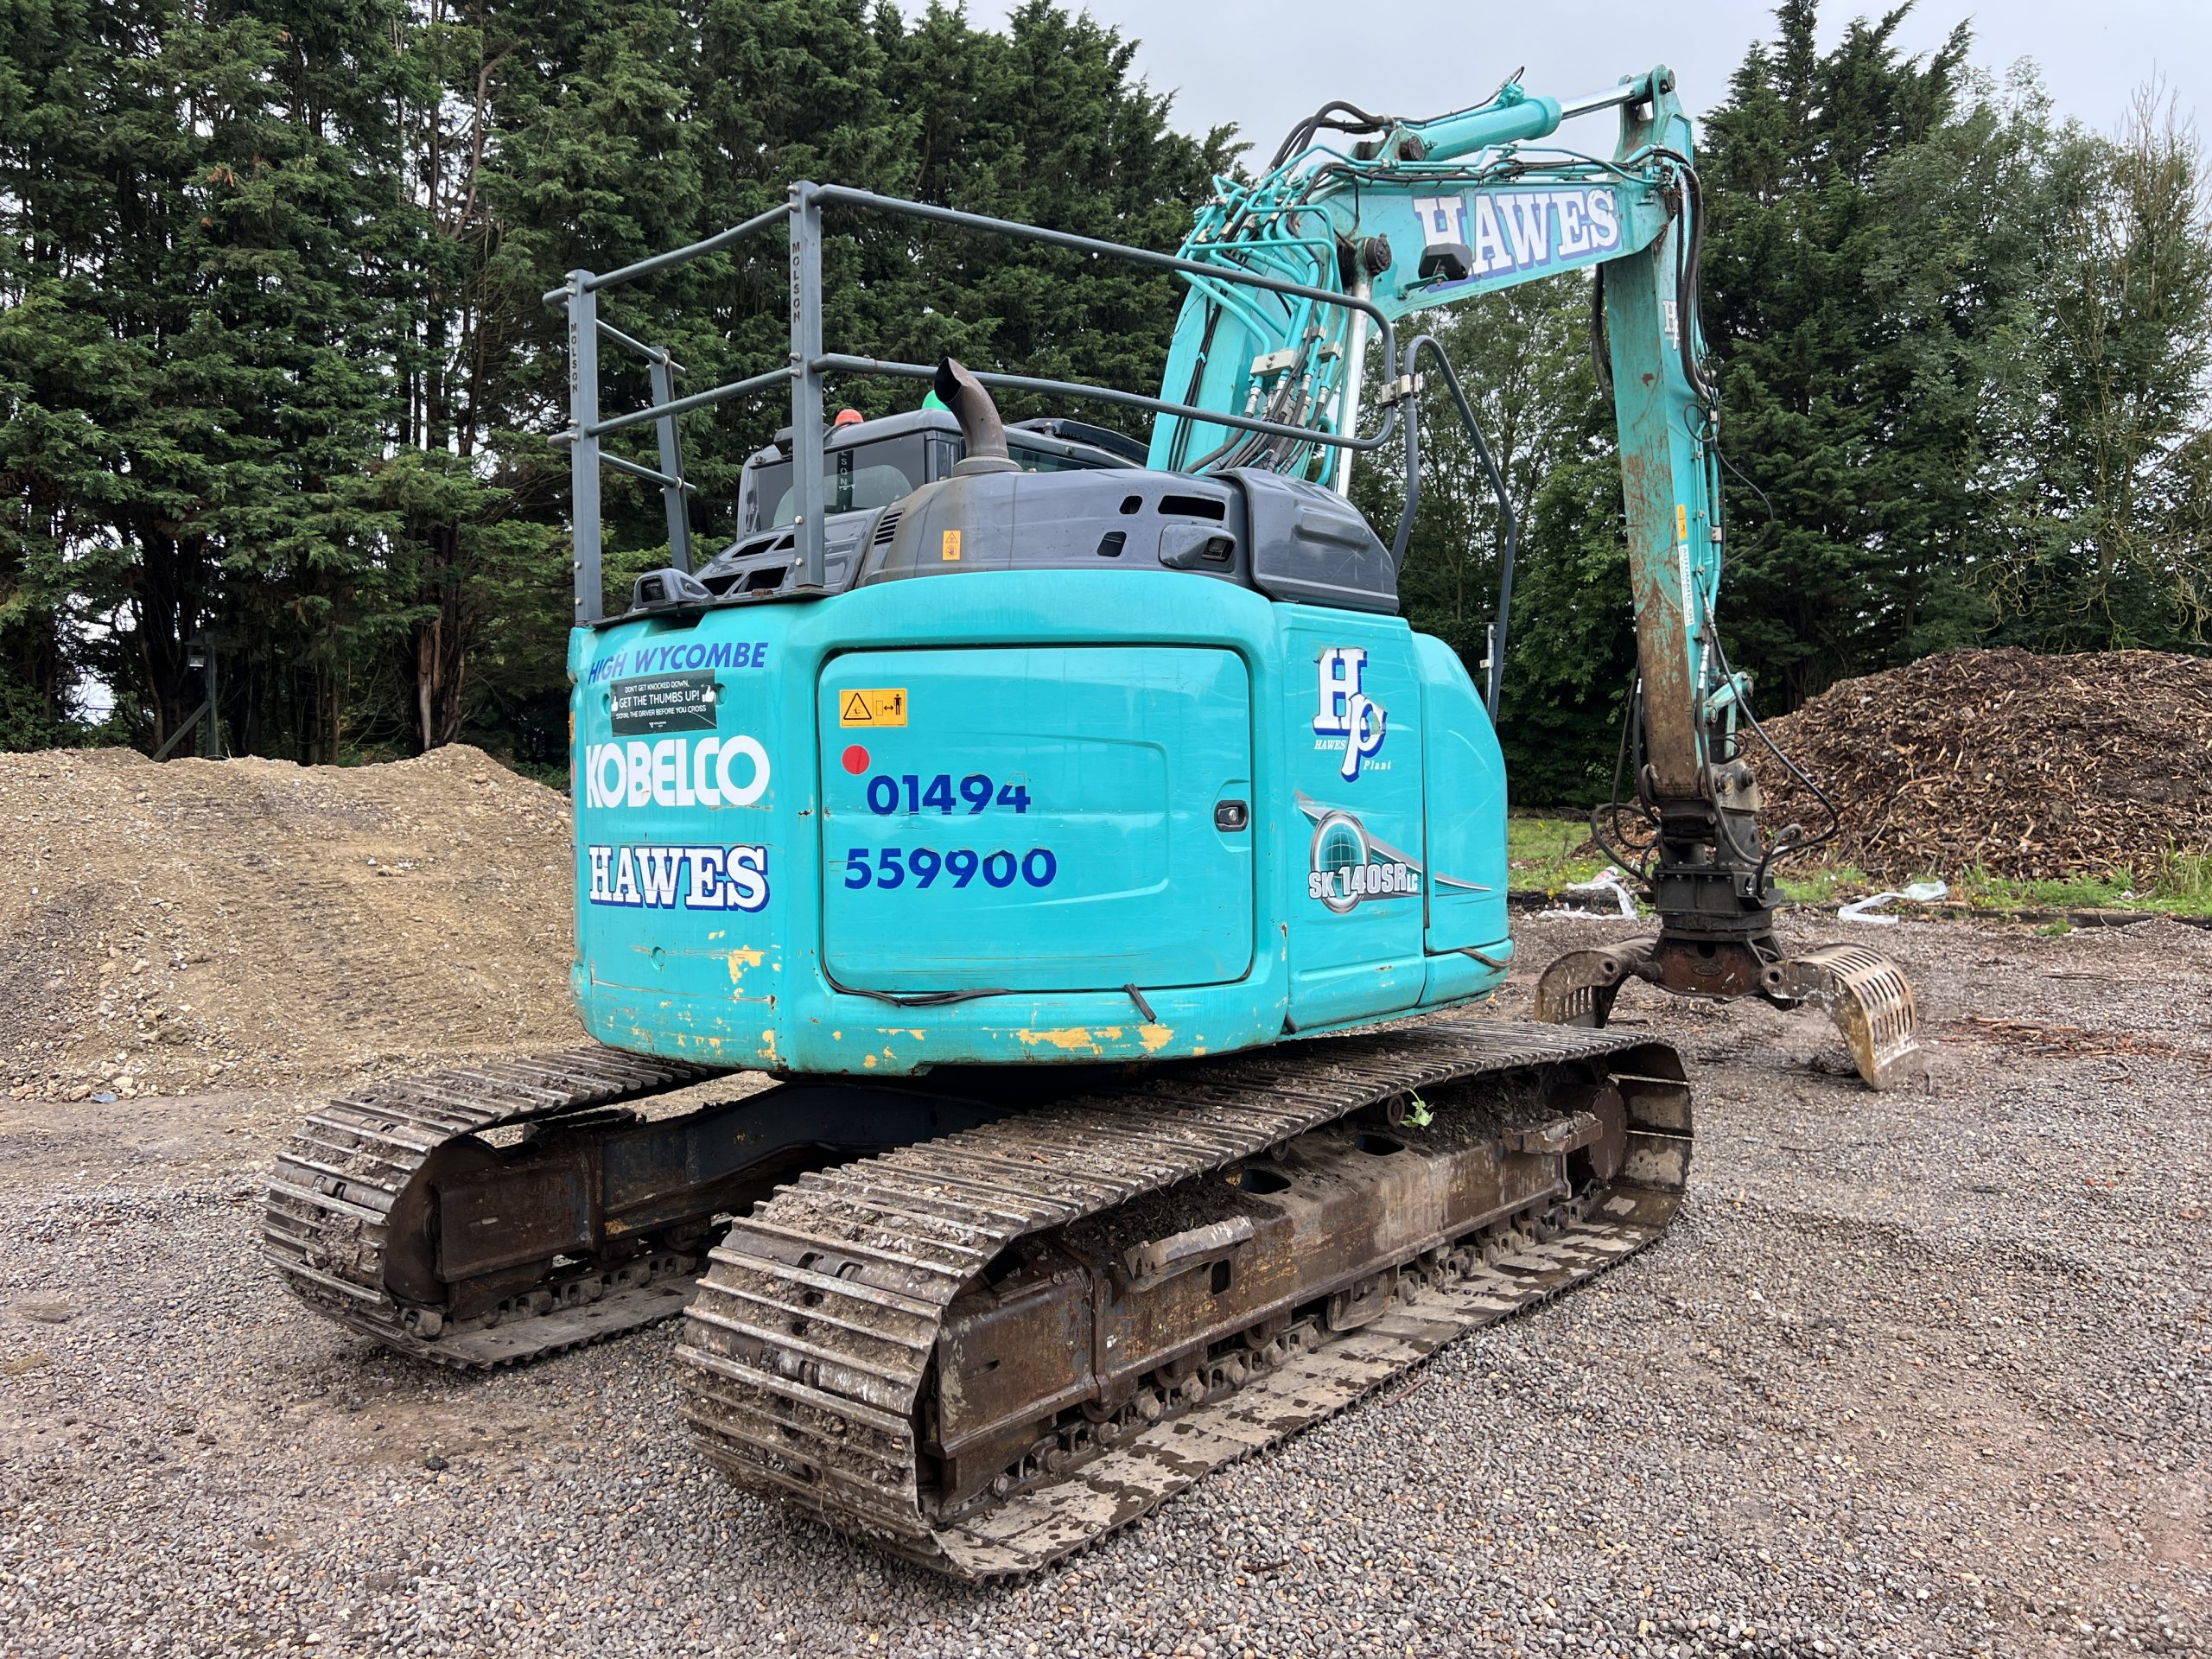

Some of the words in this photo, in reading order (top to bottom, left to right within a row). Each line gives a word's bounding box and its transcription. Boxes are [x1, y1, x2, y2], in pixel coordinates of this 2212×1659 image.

[1413, 188, 1622, 292] HAWES
[792, 242, 801, 323] MOLSON
[1683, 547, 1692, 605] AUTOMATIC
[588, 652, 626, 684] HIGH
[635, 642, 768, 674] WYCOMBE
[619, 696, 632, 709] GET
[632, 696, 647, 707] THE
[649, 690, 683, 705] THUMBS
[685, 690, 700, 702] UP!
[638, 683, 647, 692] GET
[647, 681, 671, 690] KNOCKED
[639, 709, 655, 718] DRIVER
[656, 707, 675, 716] BEFORE
[675, 706, 688, 715] YOU
[687, 704, 707, 714] CROSS
[1314, 739, 1347, 751] HAWES
[1363, 760, 1392, 771] Plant
[586, 735, 771, 808] KOBELCO
[867, 772, 1032, 817] 01494
[589, 844, 771, 912] HAWES
[844, 846, 1058, 889] 559900
[1308, 871, 1337, 899] SK
